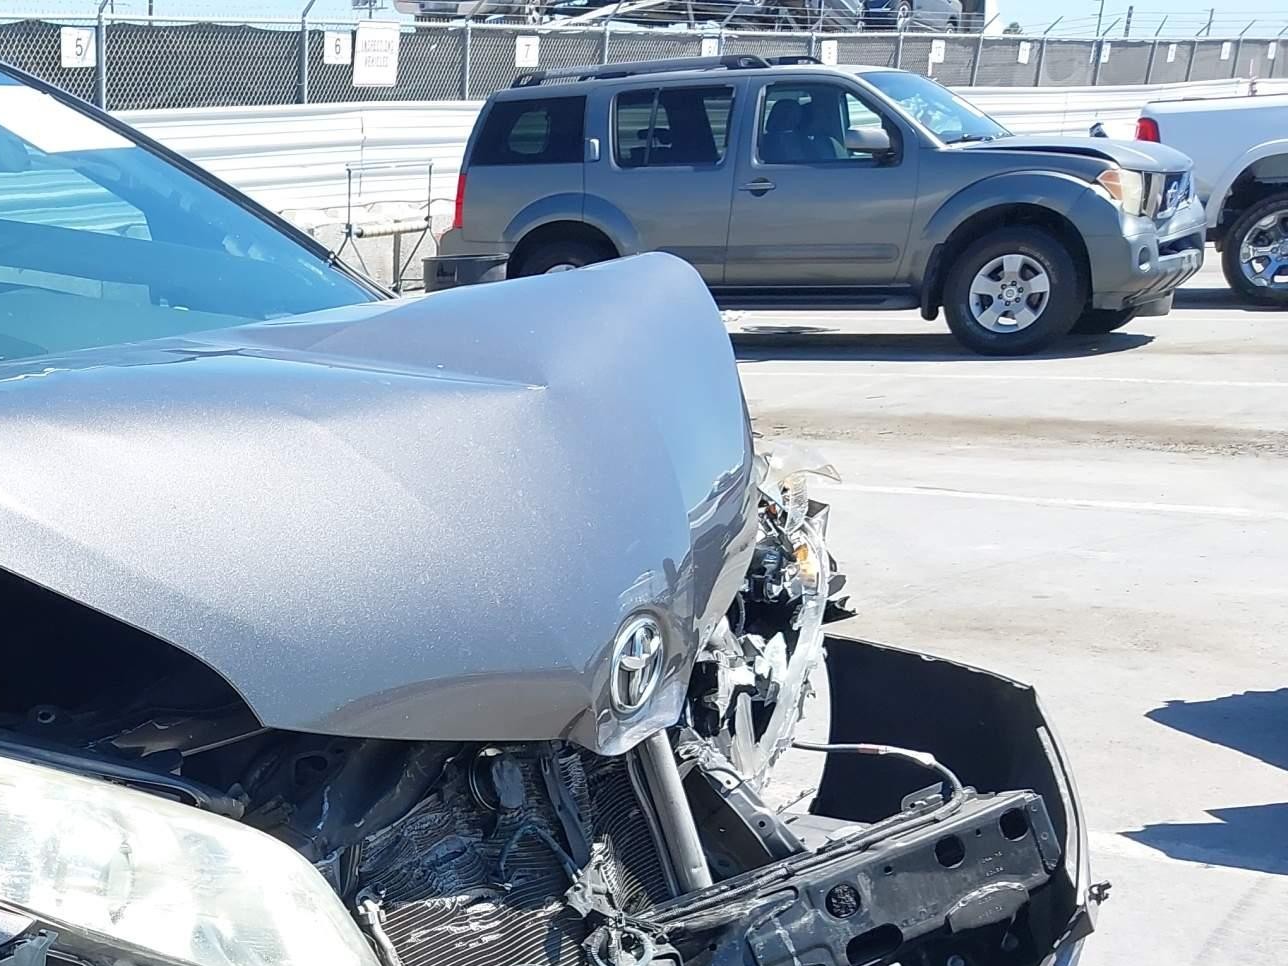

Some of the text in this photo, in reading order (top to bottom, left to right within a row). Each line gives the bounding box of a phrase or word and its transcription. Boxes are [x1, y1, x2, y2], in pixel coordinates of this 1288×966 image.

[75, 37, 83, 57] 5
[334, 38, 341, 55] 6
[524, 43, 532, 59] 7
